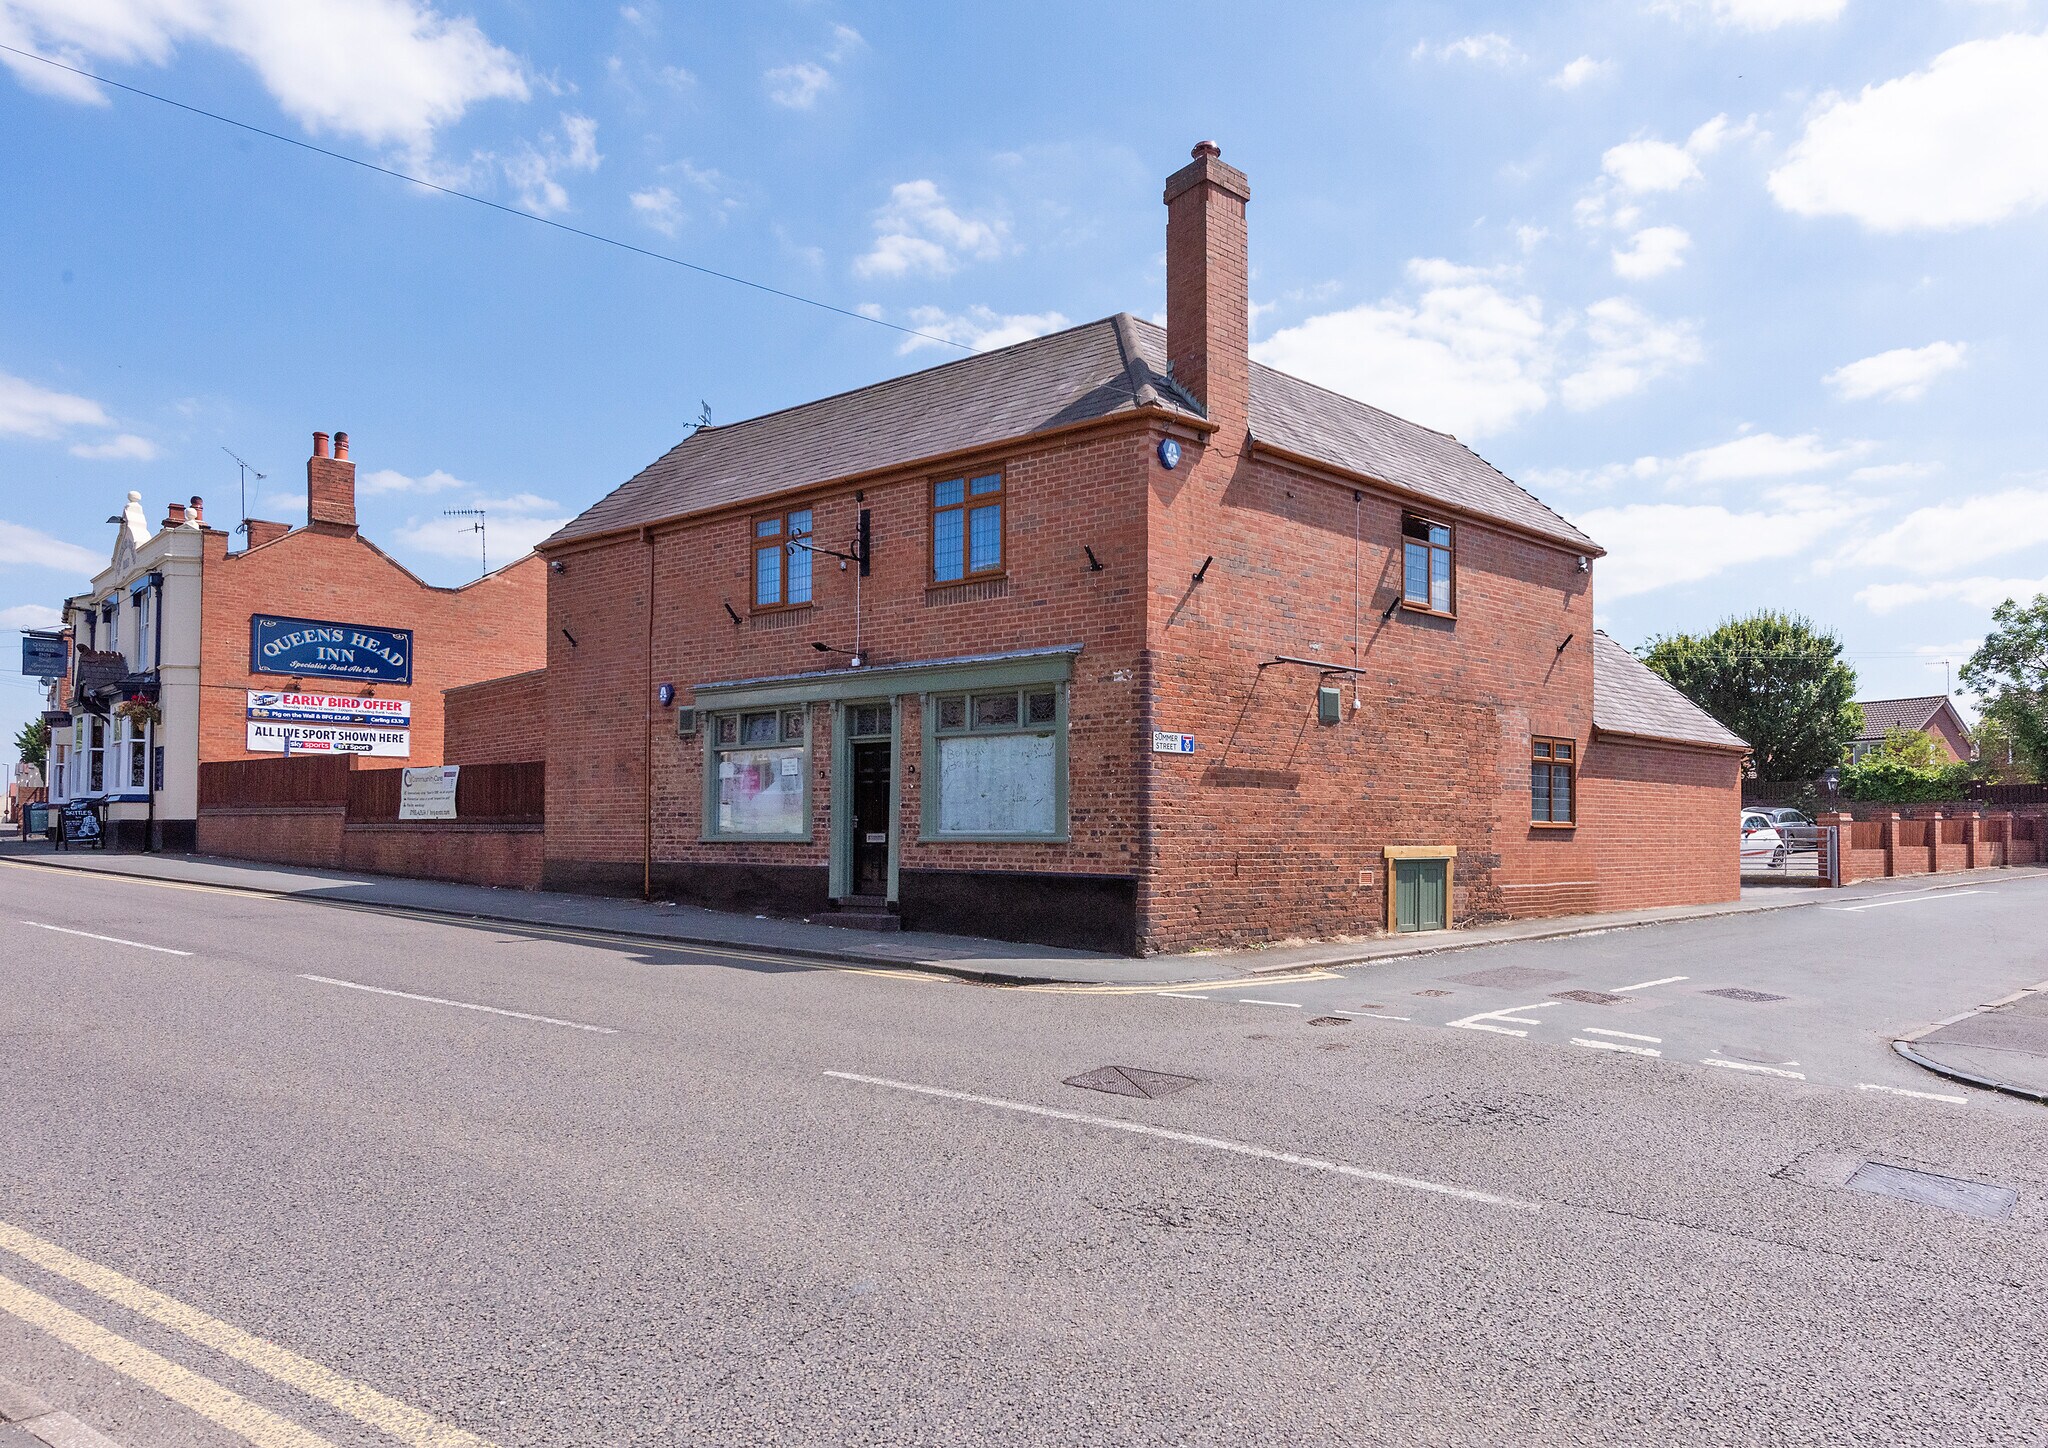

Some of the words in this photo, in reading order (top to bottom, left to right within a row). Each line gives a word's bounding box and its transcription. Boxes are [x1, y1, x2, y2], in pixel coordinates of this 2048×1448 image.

[316, 647, 355, 663] INN
[350, 632, 404, 668] HEAD
[290, 660, 326, 670] Specialist
[328, 663, 347, 672] Real
[348, 665, 362, 673] Ale
[362, 666, 379, 674] Pub
[283, 694, 325, 706] EARLY
[328, 697, 360, 709] BIRD
[363, 700, 402, 712] OFFER
[255, 726, 274, 737] ALL
[277, 728, 300, 738] LIVE
[302, 729, 336, 740] SPORT
[338, 731, 376, 743] SHOWN
[379, 733, 404, 744] HERE
[290, 740, 303, 749] sky
[304, 741, 329, 750] sports
[349, 744, 370, 752] Sport
[1156, 742, 1177, 750] STREET
